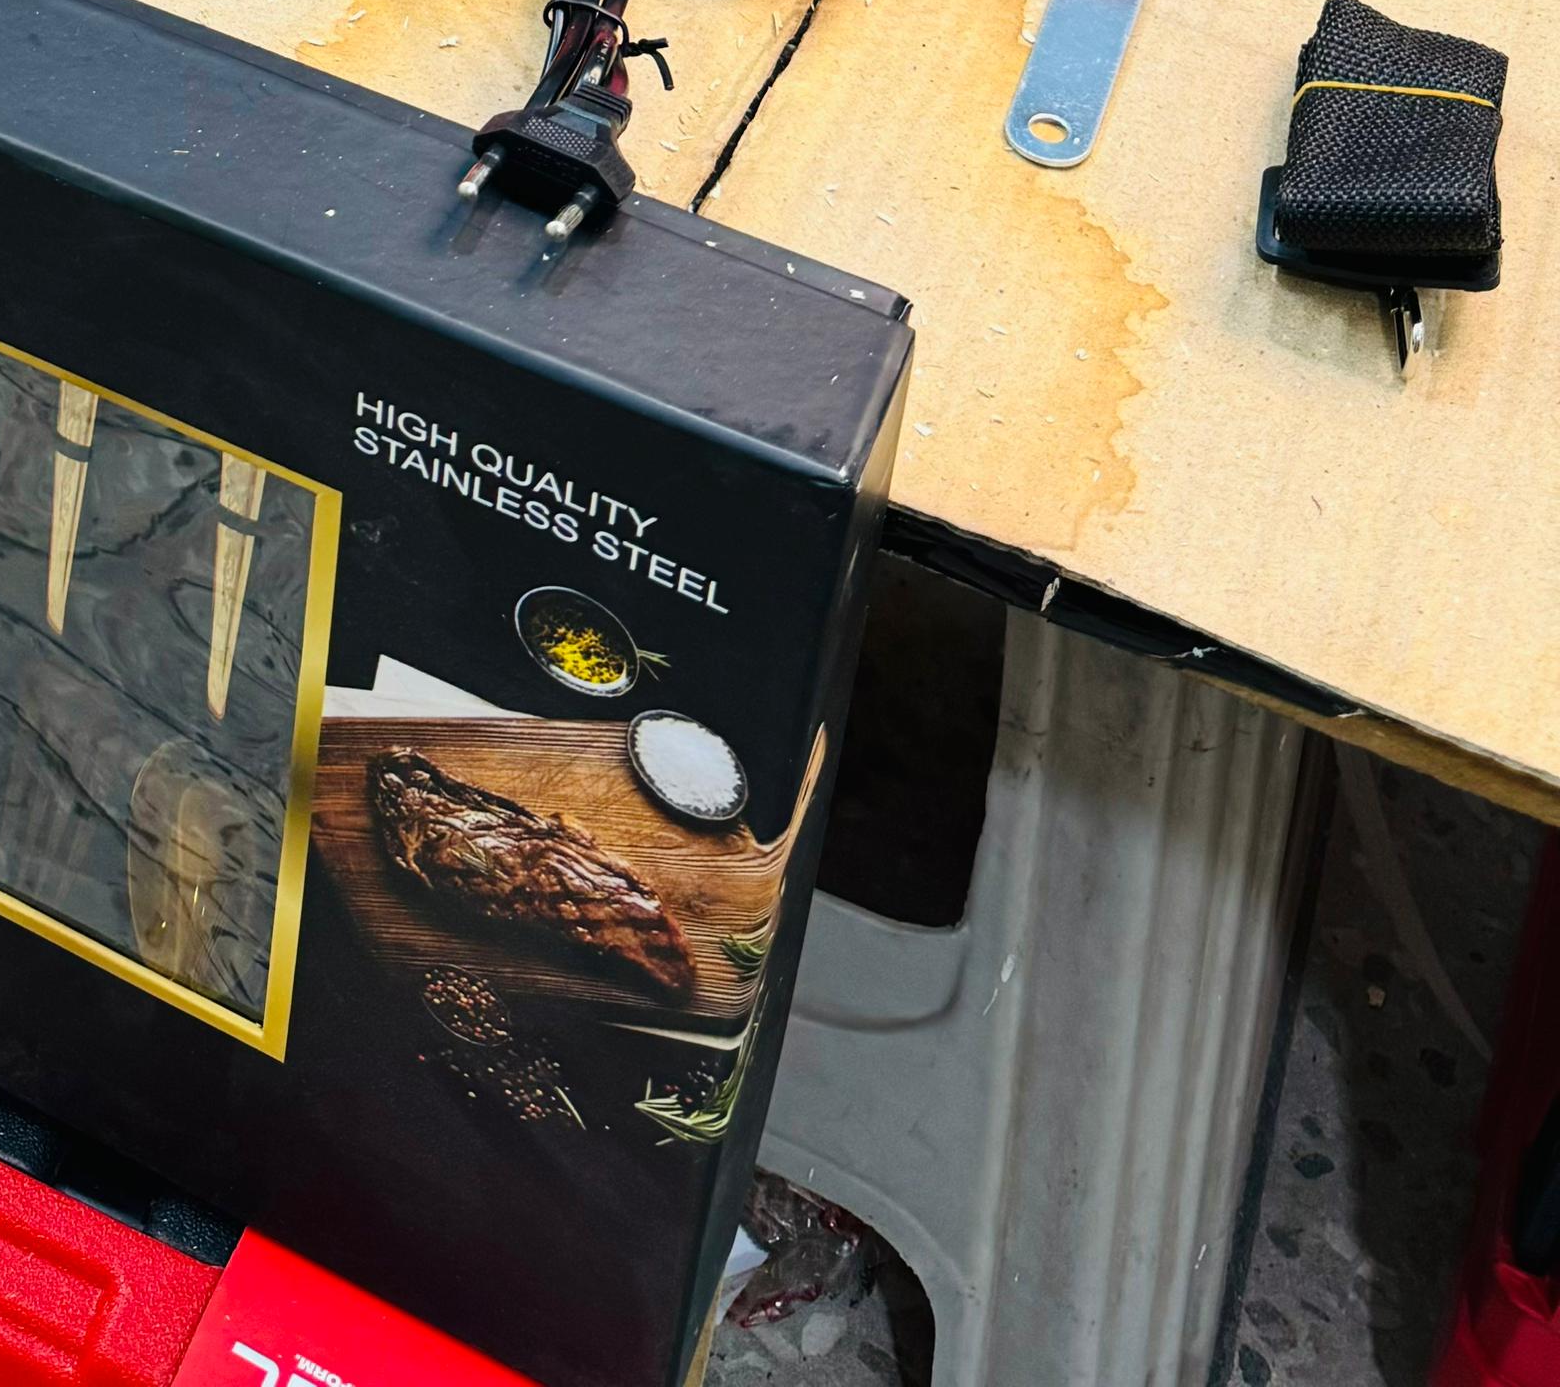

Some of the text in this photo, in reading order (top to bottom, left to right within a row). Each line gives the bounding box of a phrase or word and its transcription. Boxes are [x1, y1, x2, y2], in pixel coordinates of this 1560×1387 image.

[353, 425, 730, 615] STAINLESS STEEL
[355, 391, 658, 539] HIGH QUALITY
